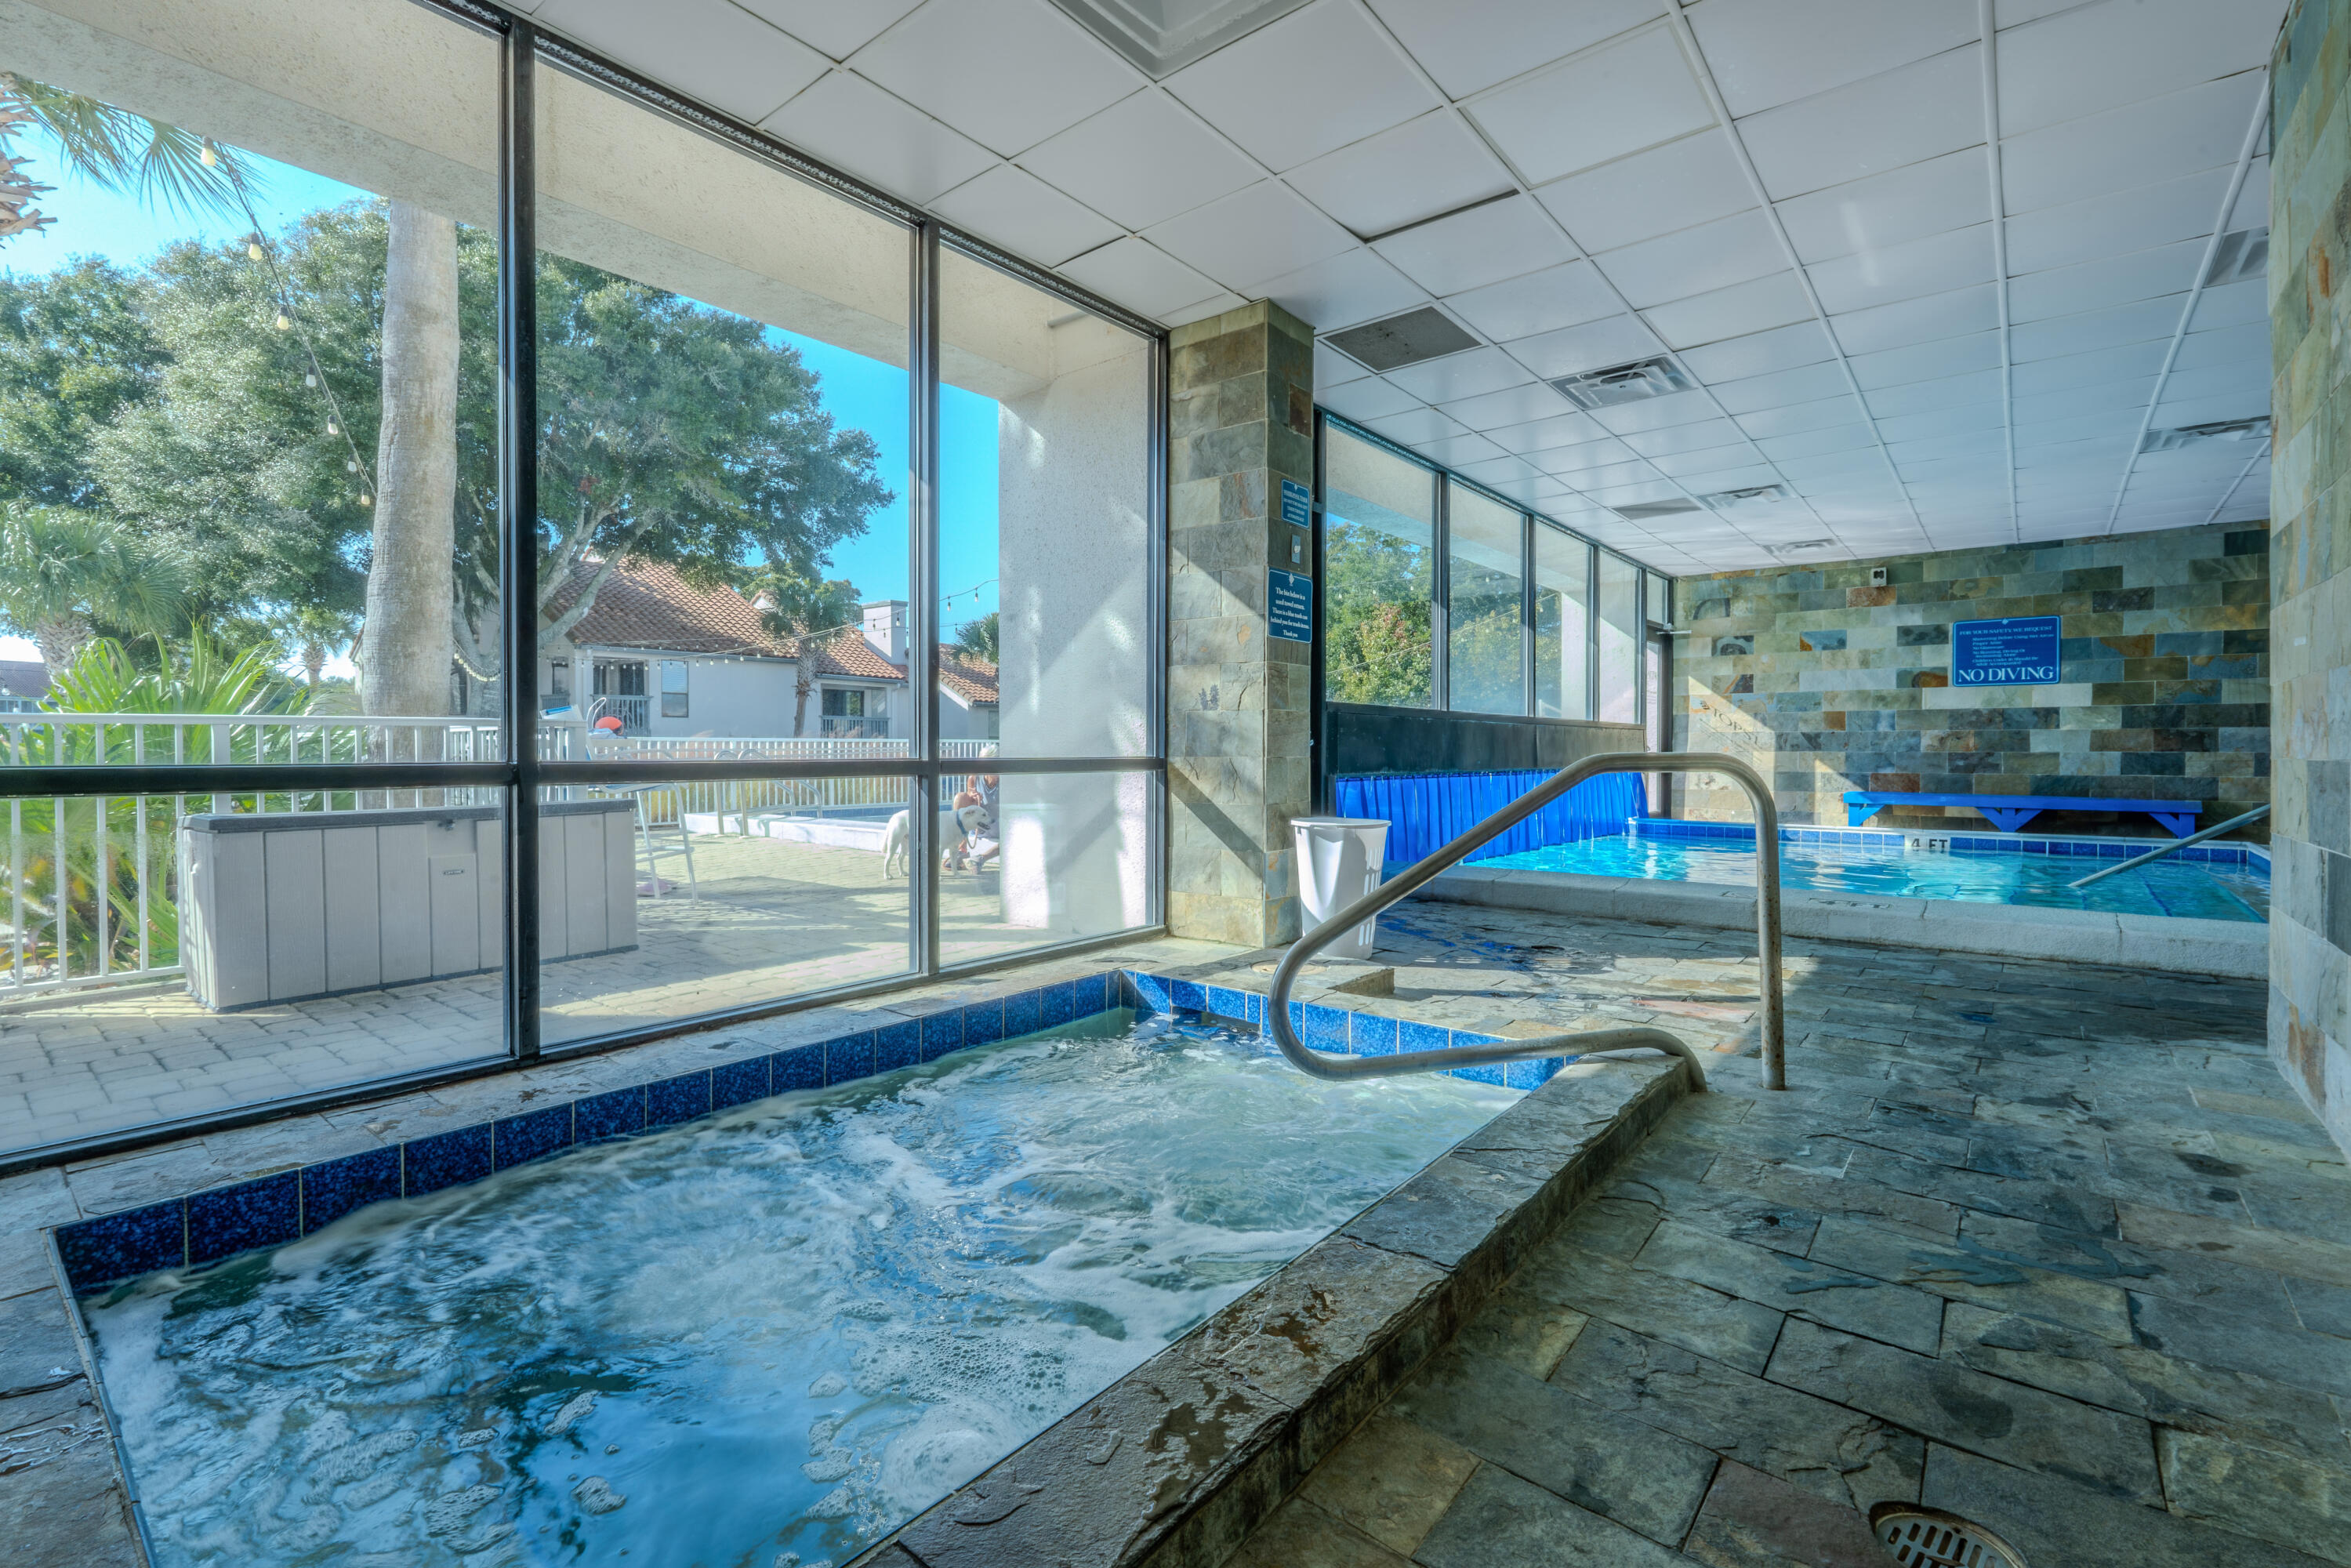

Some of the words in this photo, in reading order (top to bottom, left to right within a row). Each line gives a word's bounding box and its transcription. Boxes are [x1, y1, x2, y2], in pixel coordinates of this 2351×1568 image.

[1290, 590, 1300, 599] below
[1958, 669, 1984, 682] NO
[1988, 666, 2053, 681] DIVING
[1911, 838, 1921, 848] 4
[1929, 839, 1948, 848] FT
